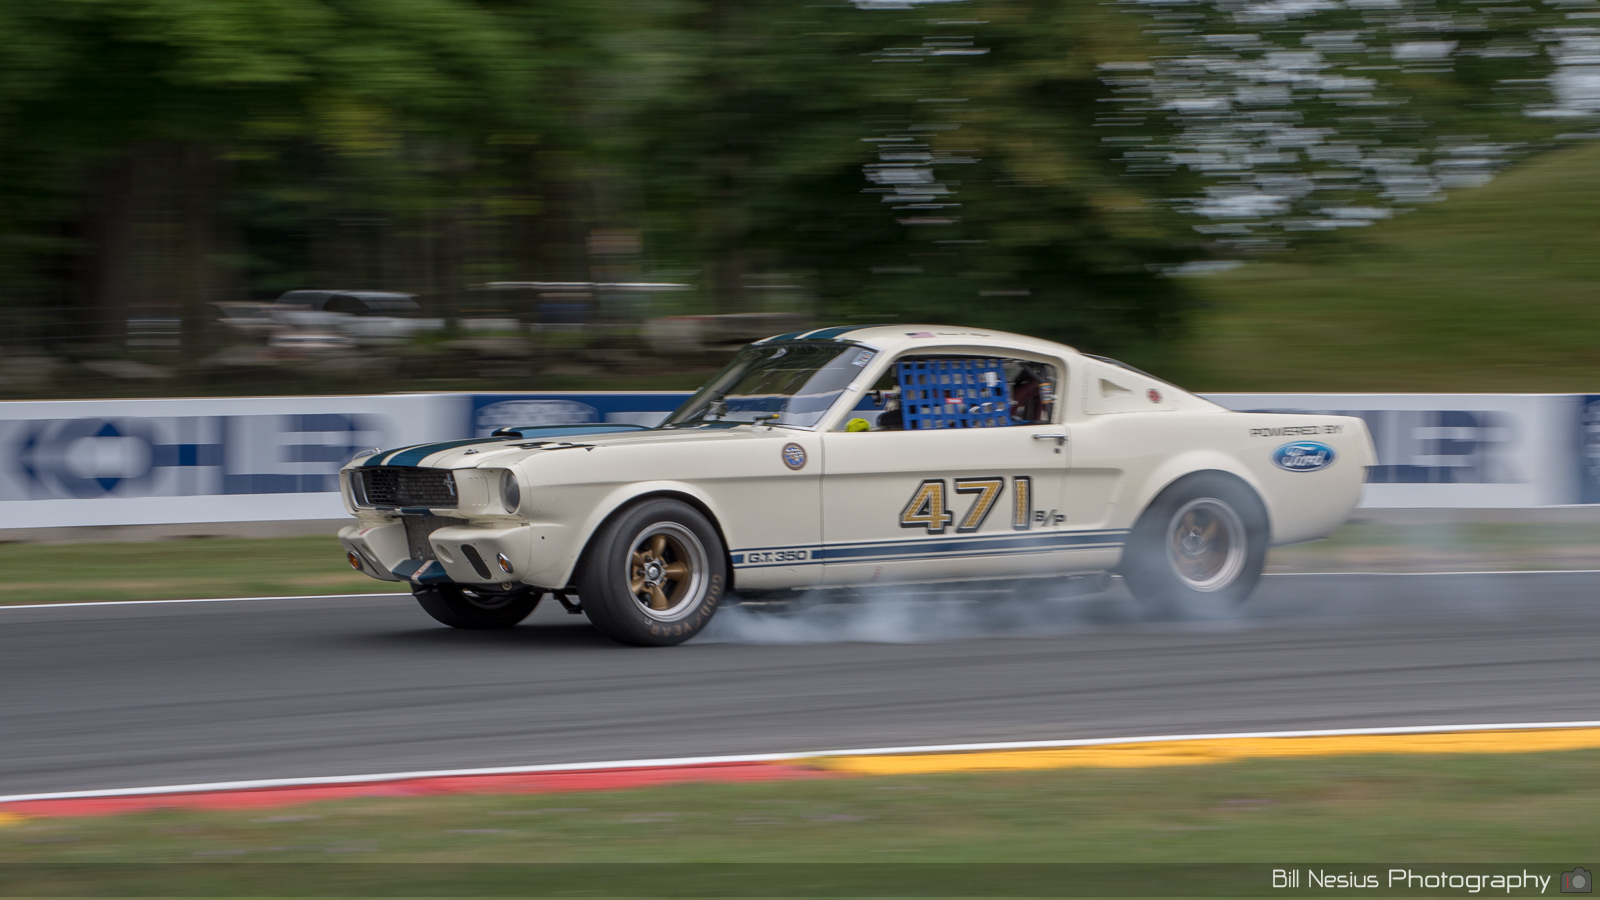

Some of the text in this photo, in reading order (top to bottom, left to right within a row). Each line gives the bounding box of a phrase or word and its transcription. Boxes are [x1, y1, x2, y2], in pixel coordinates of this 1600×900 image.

[1249, 424, 1345, 438] POWERED BY
[1281, 445, 1328, 467] Ford
[898, 475, 1033, 535] 471
[775, 549, 807, 562] 350
